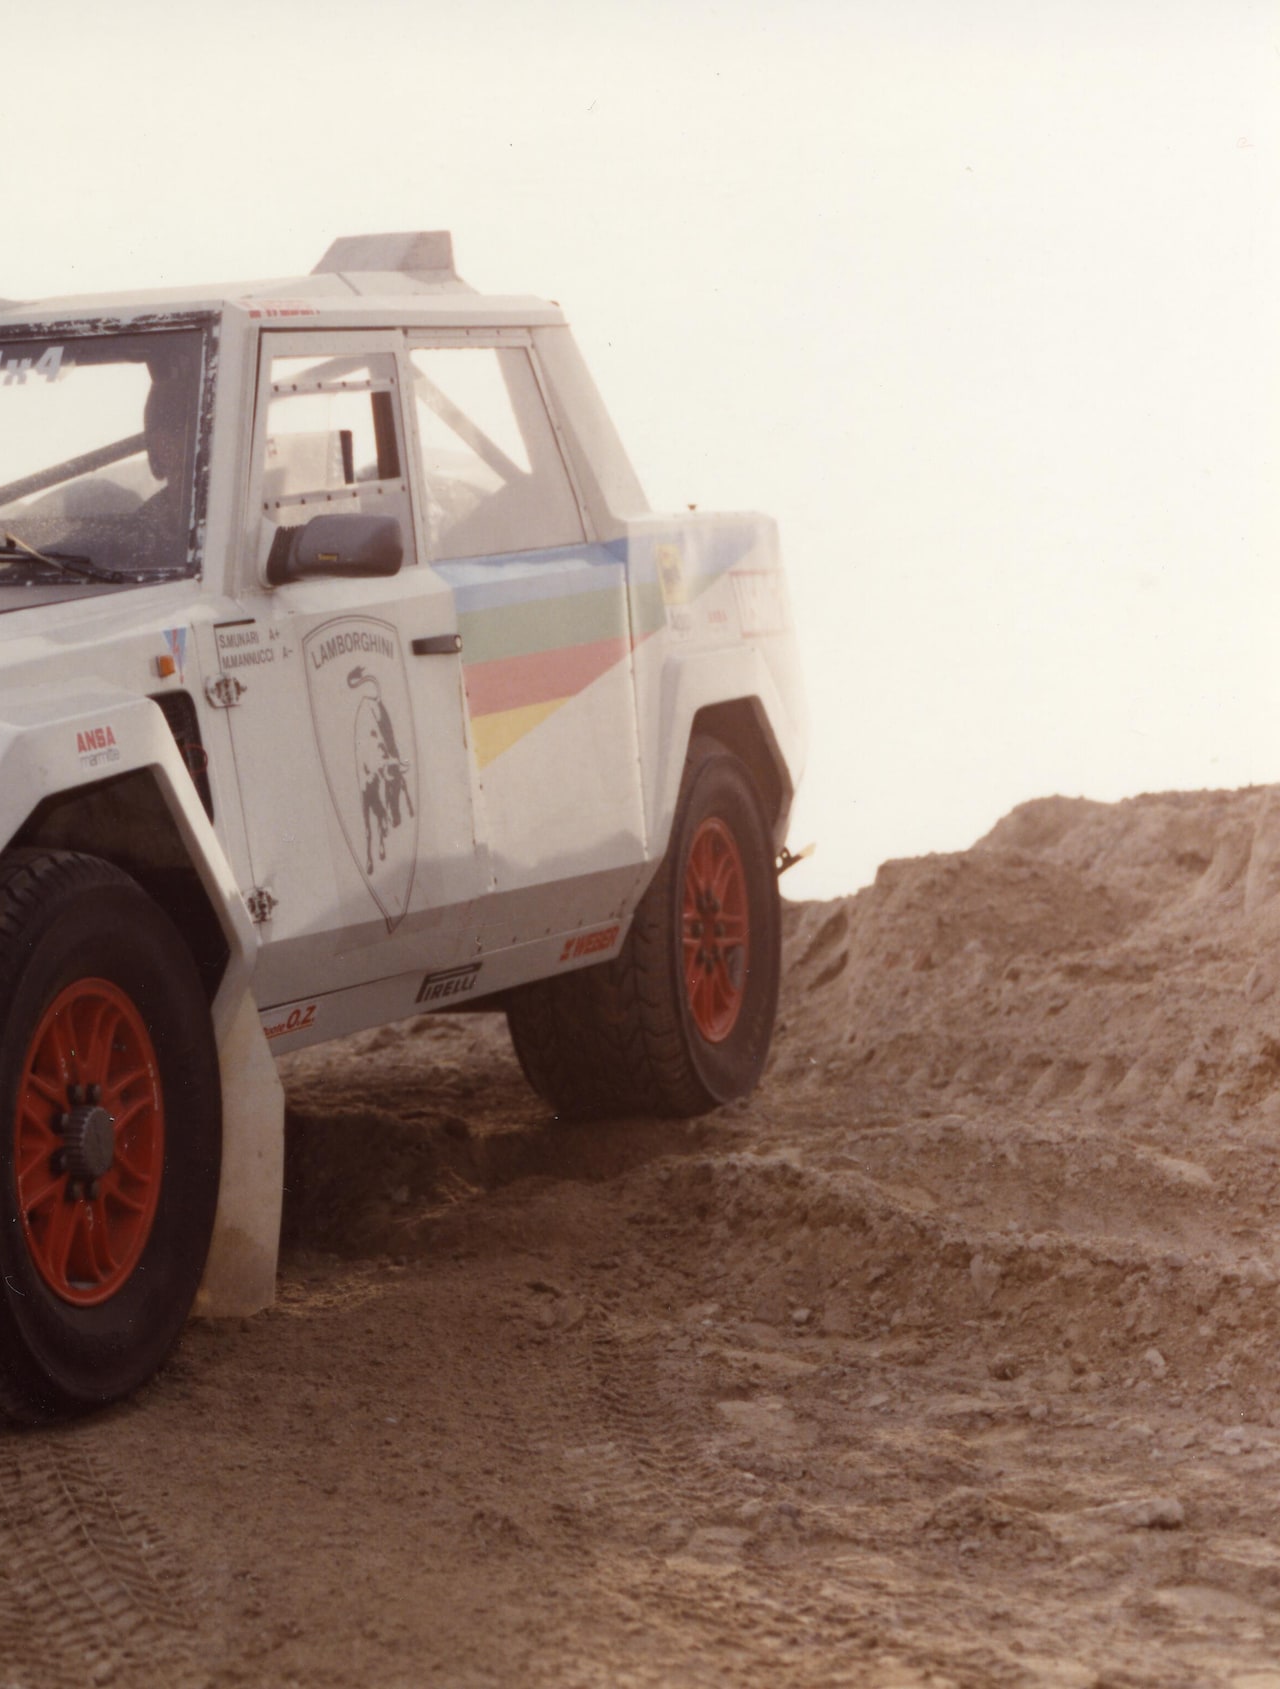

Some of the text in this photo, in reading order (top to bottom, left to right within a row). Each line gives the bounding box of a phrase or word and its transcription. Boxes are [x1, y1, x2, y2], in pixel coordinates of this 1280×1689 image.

[311, 631, 395, 670] LAMBORGHINI
[76, 725, 117, 753] ANSA
[415, 961, 483, 1004] PIRELLI
